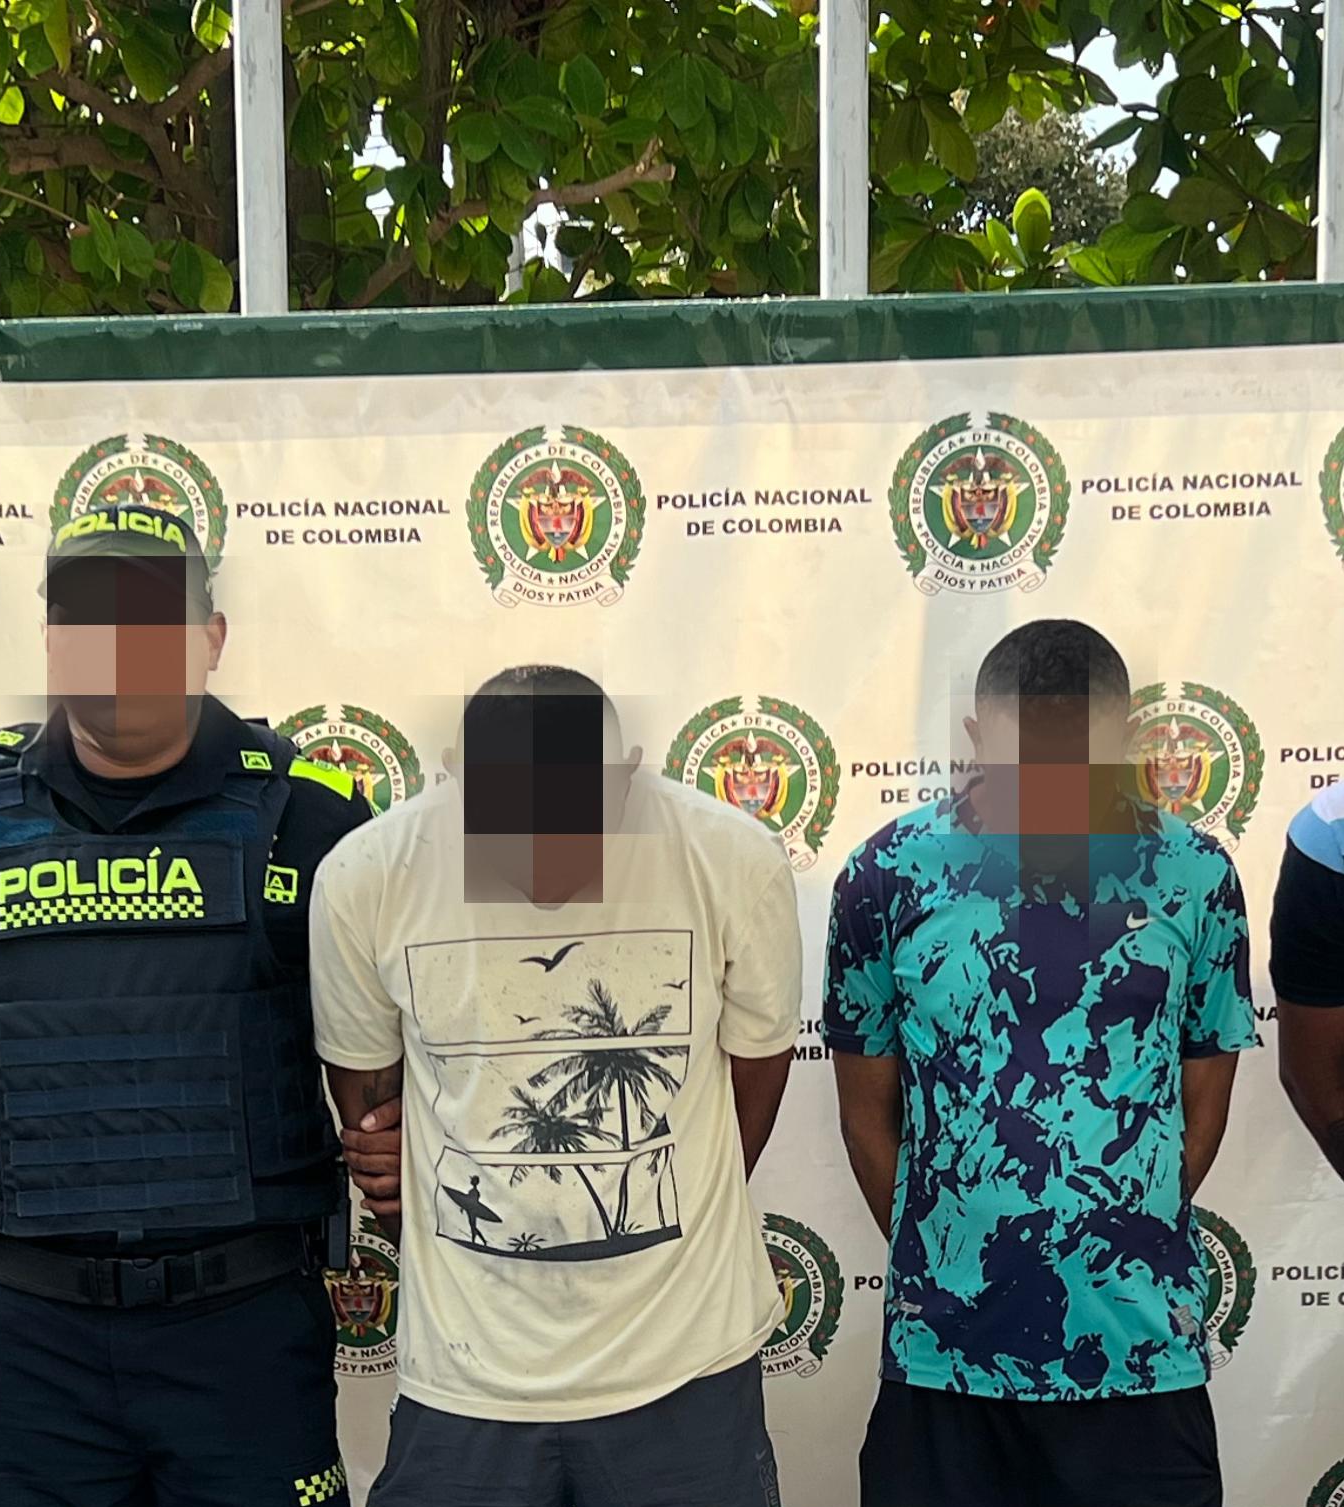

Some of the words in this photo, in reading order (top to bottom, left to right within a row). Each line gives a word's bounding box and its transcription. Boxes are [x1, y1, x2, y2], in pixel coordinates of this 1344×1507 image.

[972, 432, 992, 442] DE
[1006, 439, 1047, 512] COLOMBIA
[1081, 473, 1174, 495] POLICÍA
[1182, 471, 1303, 491] NACIONAL
[130, 454, 150, 465] DE
[163, 462, 206, 533] COLOMBIA
[547, 445, 566, 456] DE
[581, 453, 624, 526] COLOMBIA
[236, 498, 327, 519] POLICÍA
[333, 499, 451, 517] NACIONAL
[657, 487, 747, 510] POLICÍA
[754, 488, 873, 505] NACIONAL
[1111, 504, 1142, 521] DE
[1149, 501, 1272, 520] COLOMBIA
[265, 529, 295, 545] DE
[302, 528, 422, 545] COLOMBIA
[686, 520, 715, 537] DE
[722, 518, 842, 534] COLOMBIA
[558, 537, 619, 585] NACIONAL
[980, 527, 1042, 573] NACIONAL
[980, 567, 1027, 590] PATRIA
[558, 581, 605, 603] PATRIA
[1167, 702, 1186, 713] DE
[1200, 709, 1242, 779] COLOMBIA
[328, 724, 347, 736] DE
[360, 732, 403, 803] COLOMBIA
[743, 716, 762, 726] DE
[777, 724, 818, 793] COLOMBIA
[851, 756, 942, 777] POLICÍA
[1310, 773, 1340, 790] DE
[880, 787, 911, 804] DE
[782, 1239, 823, 1305] COLOMBIA
[1201, 1232, 1234, 1295] OLOMBIA
[1300, 1291, 1330, 1307] DE
[759, 1318, 818, 1358] NACIONAL
[361, 1356, 398, 1374] PATRI
